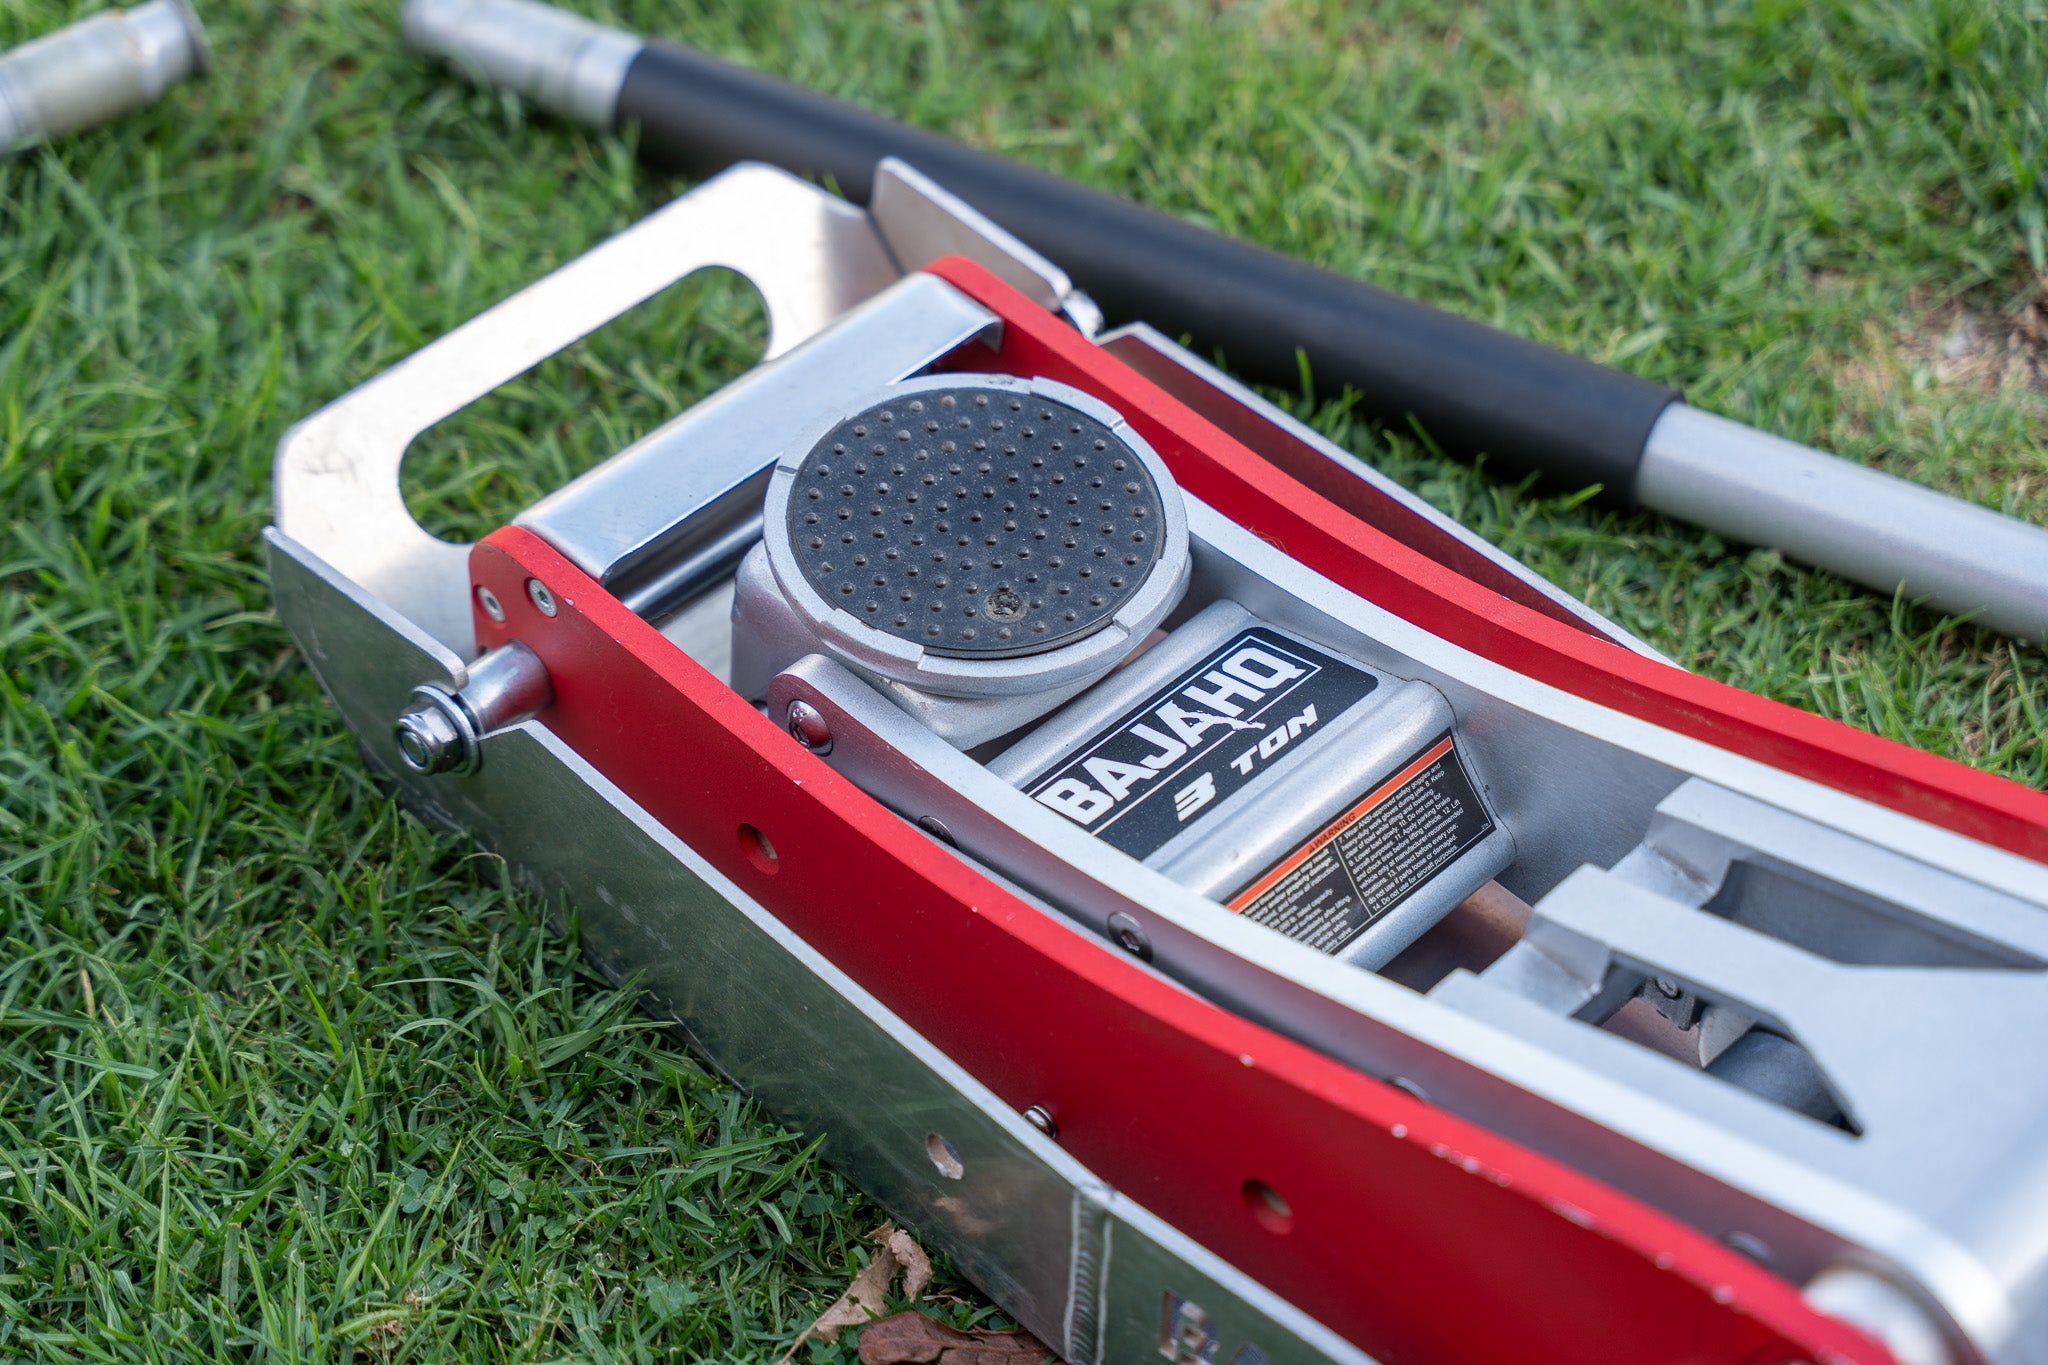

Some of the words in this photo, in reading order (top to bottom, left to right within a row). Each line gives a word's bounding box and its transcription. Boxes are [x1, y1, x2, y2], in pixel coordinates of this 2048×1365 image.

[1035, 647, 1307, 825] BAJAHQ
[1174, 772, 1216, 822] 3
[1230, 704, 1319, 776] TON
[1311, 810, 1356, 851] WARNING
[1337, 835, 1345, 845] 7.
[1342, 823, 1359, 840] Wear
[1356, 794, 1396, 830] ANSI-approved
[1394, 783, 1412, 801] safety
[1409, 769, 1431, 790] goggles
[1429, 761, 1441, 773] and
[1340, 826, 1370, 853] heavy-duty
[1367, 816, 1382, 831] work
[1380, 803, 1399, 822] gloves
[1396, 791, 1414, 809] during
[1413, 783, 1426, 796] use.
[1424, 778, 1432, 788] 8.
[1430, 768, 1446, 784] Keep
[1344, 845, 1359, 860] clear
[1357, 840, 1365, 850] of
[1362, 831, 1376, 845] load
[1374, 821, 1390, 836] while
[1388, 810, 1404, 827] lifting
[1401, 803, 1413, 815] and
[1411, 787, 1434, 809] lowering
[1347, 857, 1355, 867] 9.
[1353, 845, 1371, 863] Lower
[1369, 836, 1382, 850] load
[1380, 824, 1399, 843] slowly.
[1398, 817, 1407, 828] 10.
[1406, 811, 1416, 822] Do
[1414, 804, 1425, 815] not
[1423, 798, 1434, 809] use
[1432, 791, 1442, 801] for
[1351, 856, 1371, 875] aircraft
[1369, 838, 1395, 862] purposes.
[1394, 831, 1403, 842] 11.
[1401, 820, 1418, 837] Apply
[1416, 806, 1437, 826] parking
[1434, 795, 1451, 811] brake
[1299, 860, 1314, 875] may
[1311, 846, 1329, 865] result
[1309, 860, 1340, 888] instructions
[1354, 869, 1367, 882] and
[1365, 857, 1382, 874] chock
[1380, 849, 1393, 862] tires
[1391, 836, 1409, 854] before
[1408, 826, 1424, 842] lifting
[1422, 811, 1443, 831] vehicle.
[1441, 804, 1452, 816] 12.
[1450, 798, 1461, 809] Lift
[1358, 871, 1378, 890] vehicle
[1376, 863, 1390, 877] only
[1387, 858, 1396, 867] at
[1393, 805, 1464, 864] manufacturer-recommended
[1362, 874, 1388, 898] locations.
[1387, 867, 1397, 879] 13.
[1395, 853, 1416, 873] Inspect
[1414, 840, 1432, 858] before
[1431, 830, 1448, 847] every
[1366, 894, 1377, 905] do
[1374, 887, 1385, 900] not
[1383, 880, 1395, 893] use
[1393, 876, 1400, 885] if
[1397, 866, 1413, 883] parts
[1411, 855, 1427, 871] loose
[1425, 851, 1433, 860] or
[1431, 832, 1458, 857] damaged.
[1284, 871, 1311, 897] property
[1322, 904, 1337, 920] after
[1372, 900, 1382, 912] 14.
[1380, 894, 1391, 906] Do
[1388, 887, 1400, 899] not
[1397, 880, 1409, 892] use
[1407, 873, 1417, 885] for
[1415, 860, 1435, 879] aircraft
[1432, 842, 1459, 866] purposes.
[1331, 918, 1347, 934] while
